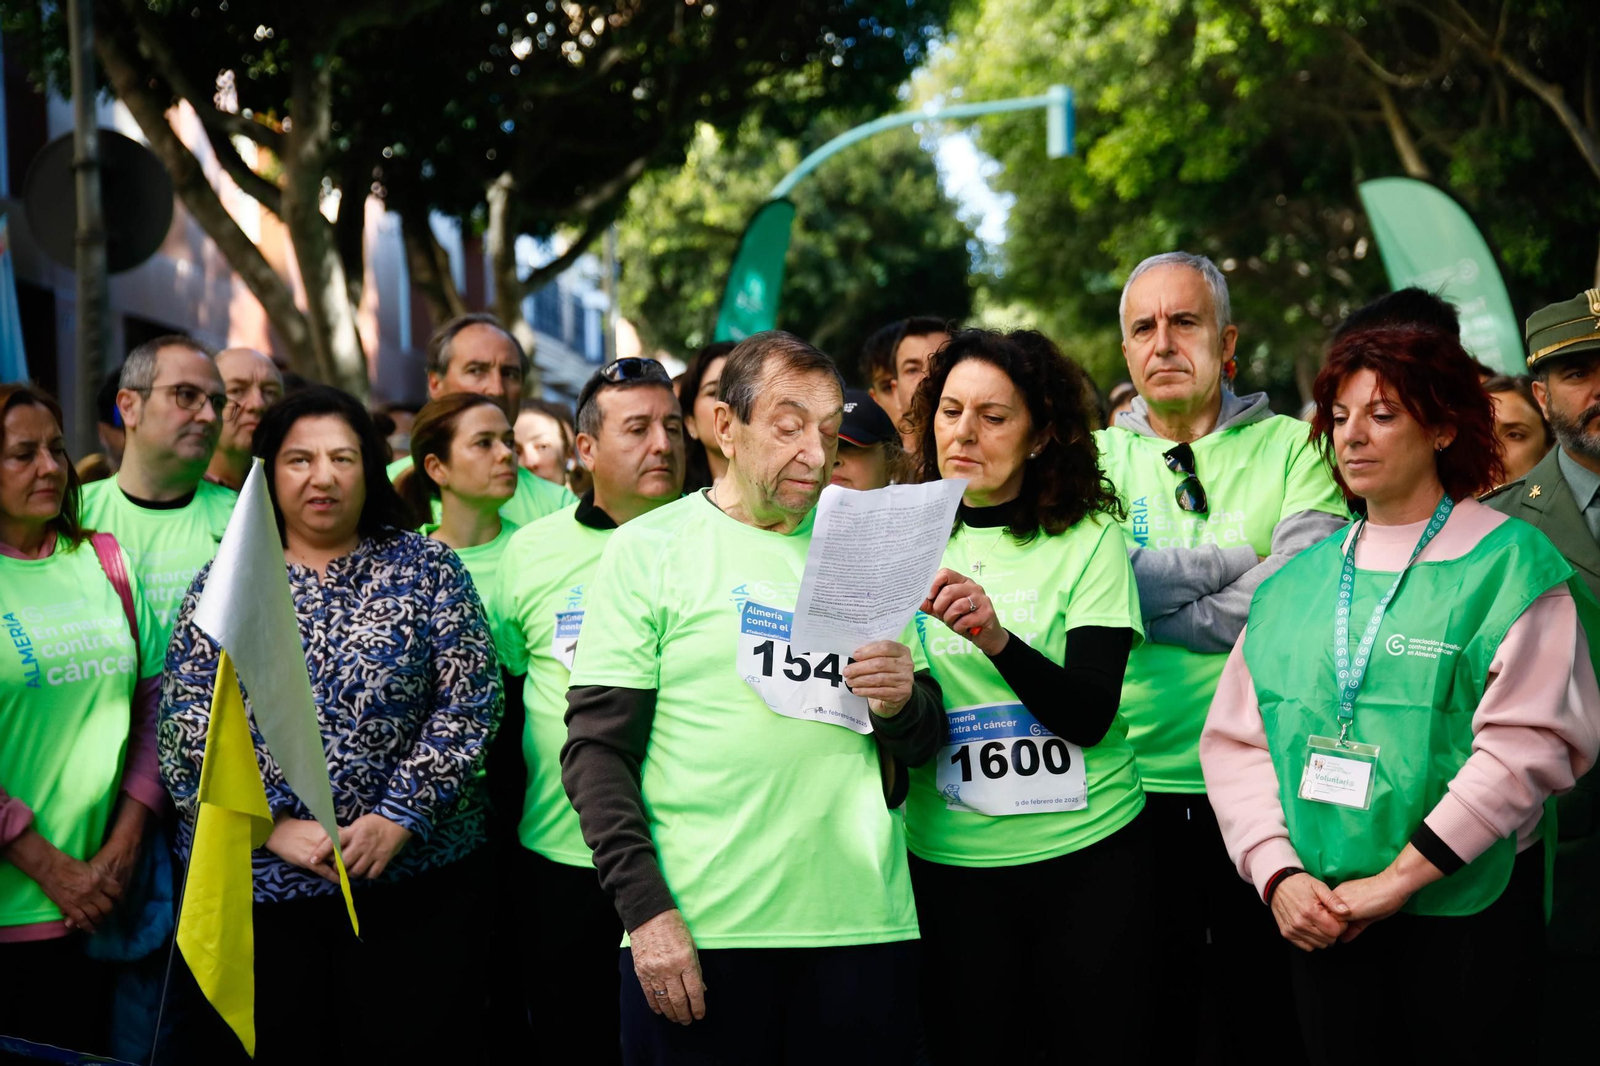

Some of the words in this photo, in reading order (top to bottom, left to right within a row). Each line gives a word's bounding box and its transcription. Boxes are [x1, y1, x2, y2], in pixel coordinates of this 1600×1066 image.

[1130, 496, 1149, 548] MERÍA
[1223, 522, 1248, 542] el
[747, 605, 783, 621] Almería
[1012, 603, 1037, 623] el
[746, 617, 778, 630] contra
[779, 624, 790, 633] el
[30, 626, 59, 641] En
[1409, 637, 1440, 646] asociación
[3, 612, 42, 688] ALMERÍA
[41, 633, 114, 658] contra
[1408, 643, 1426, 651] contra
[1434, 647, 1453, 656] cáncer
[1415, 650, 1437, 659] Almería
[752, 640, 856, 695] 154
[948, 713, 976, 725] lmería
[948, 724, 971, 735] ontra
[972, 722, 982, 731] el
[983, 720, 1017, 730] cáncer
[951, 738, 1071, 783] 1600
